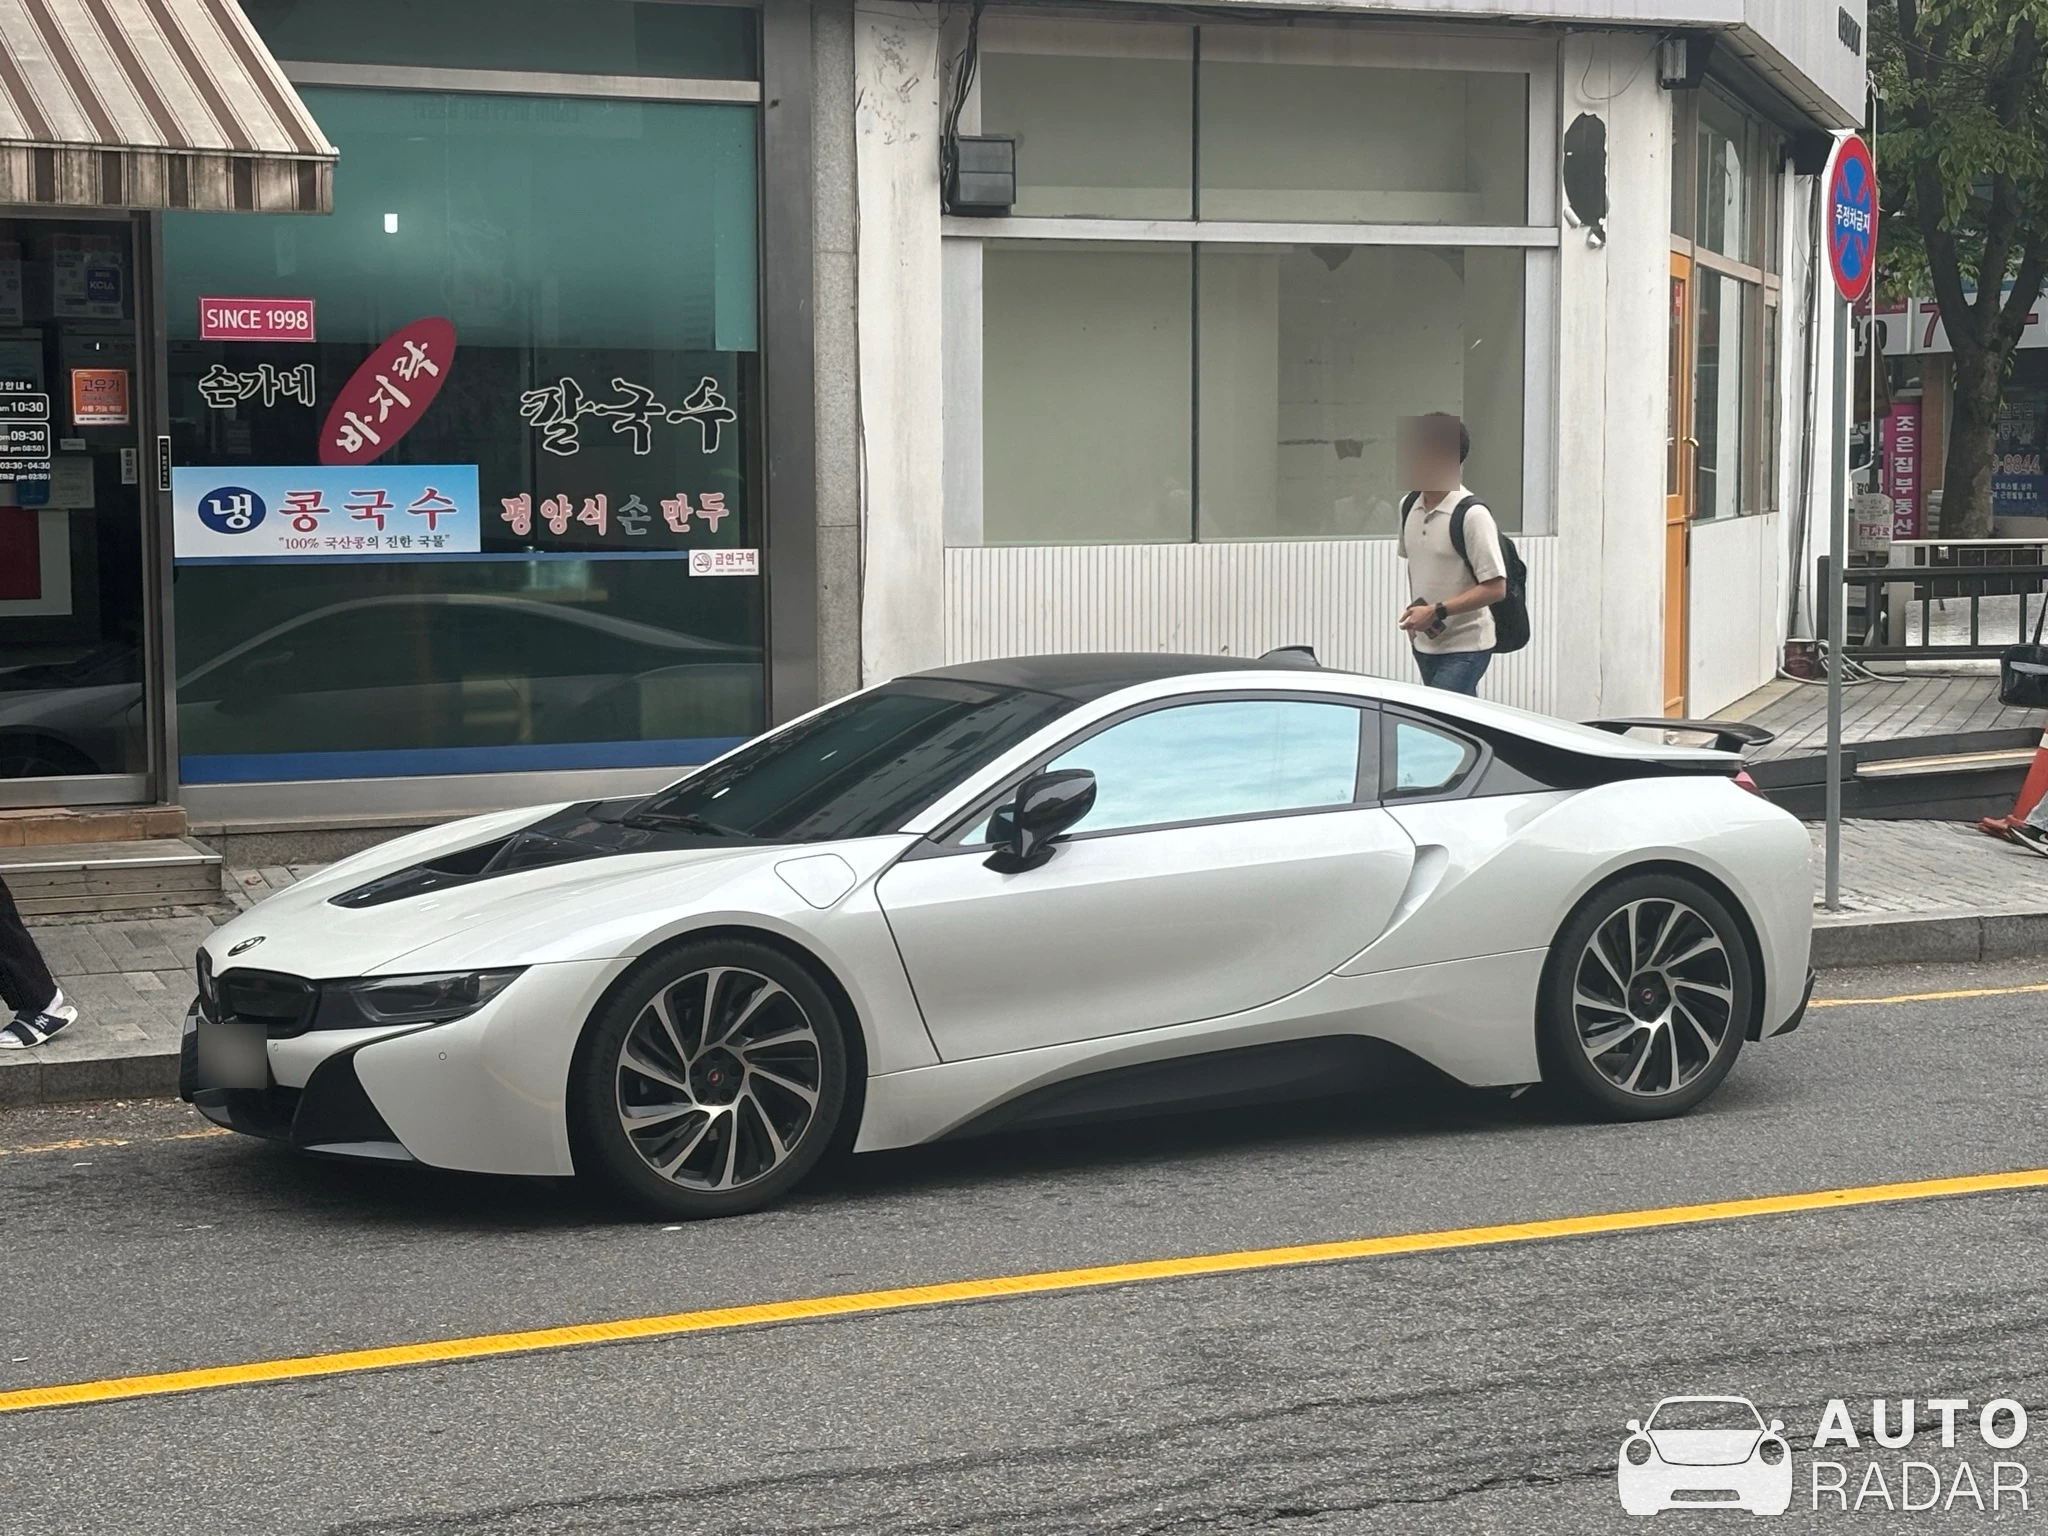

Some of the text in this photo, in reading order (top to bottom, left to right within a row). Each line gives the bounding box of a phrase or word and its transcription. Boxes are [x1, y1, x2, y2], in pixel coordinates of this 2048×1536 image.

[1836, 204, 1871, 235] 주정차금지
[206, 308, 309, 330] SINCE 1998
[81, 378, 120, 392] 고유가
[198, 364, 316, 408] 손가네
[336, 340, 440, 453] 바지락
[10, 401, 44, 413] 10:30
[520, 376, 737, 456] 칼국수
[10, 430, 45, 442] 09:30
[1894, 415, 1914, 536] 조은집부동산
[207, 487, 458, 533] 냉 콩국수
[323, 536, 380, 550] 국산콩의
[384, 535, 413, 549] 진한
[715, 552, 755, 566] 금연구역
